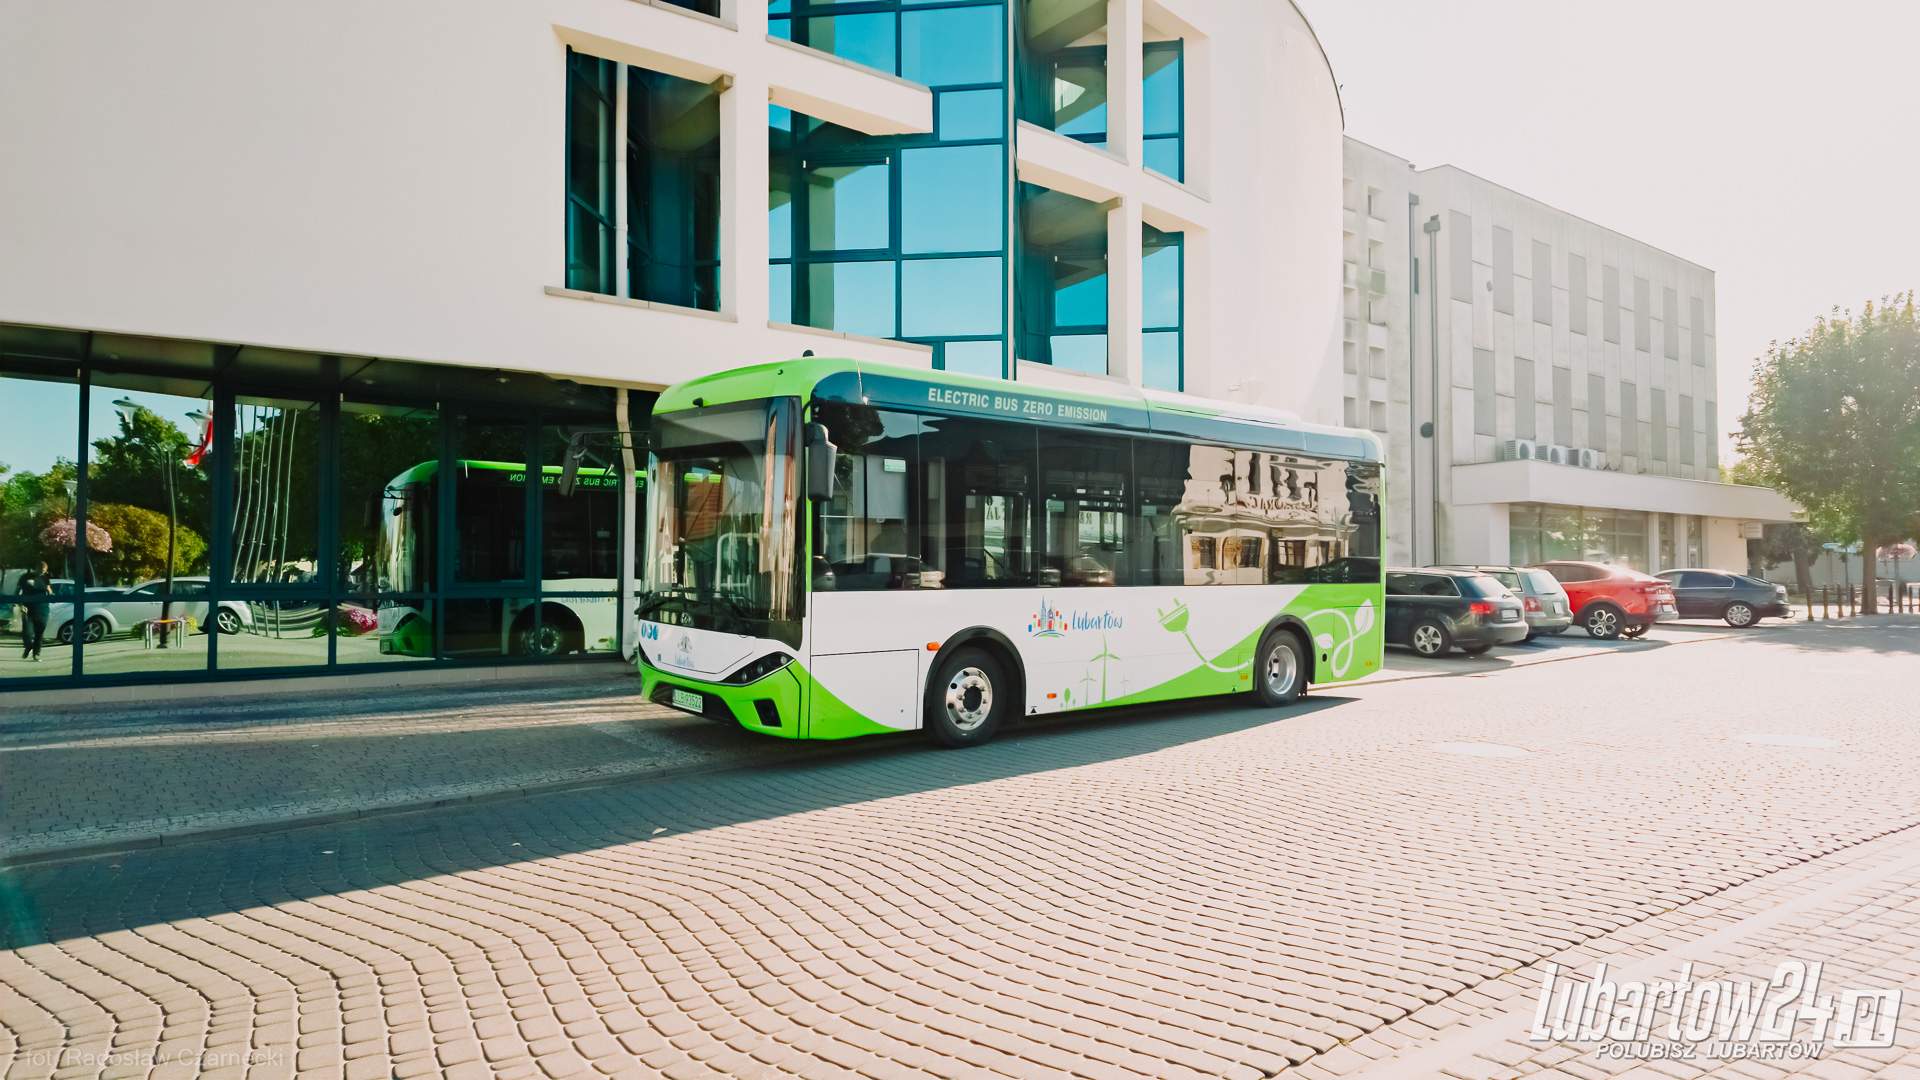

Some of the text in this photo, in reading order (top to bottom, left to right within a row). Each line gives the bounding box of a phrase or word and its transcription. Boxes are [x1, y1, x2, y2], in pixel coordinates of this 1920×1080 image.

[928, 388, 1107, 422] ELECTRIC BUS ZERO EMISSION
[1072, 608, 1123, 631] Lubartów
